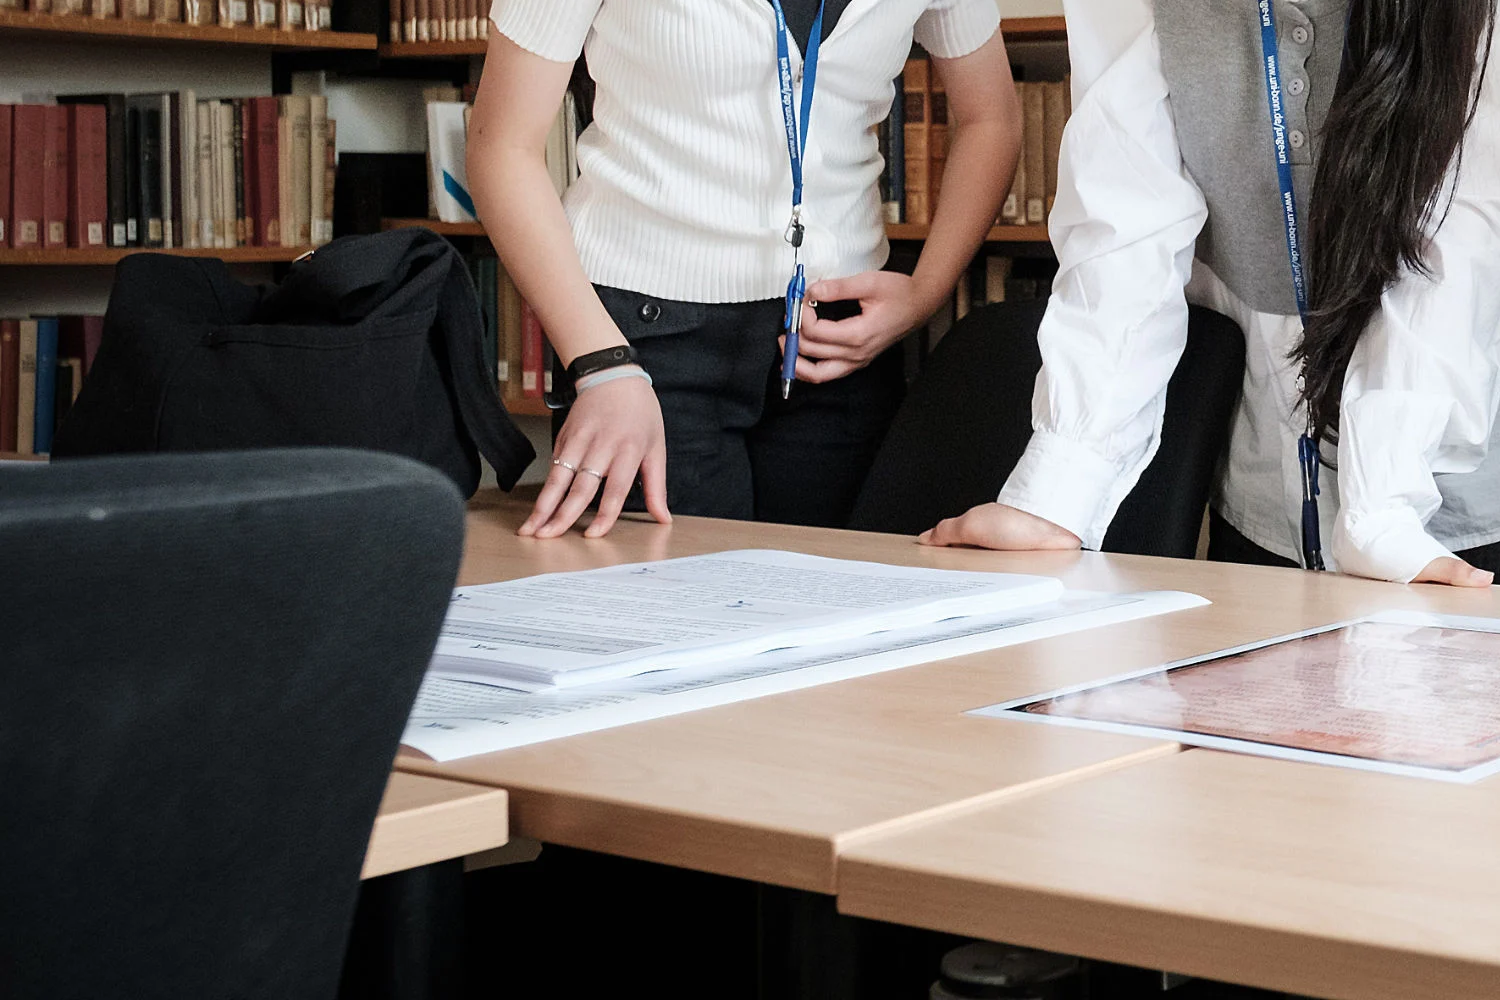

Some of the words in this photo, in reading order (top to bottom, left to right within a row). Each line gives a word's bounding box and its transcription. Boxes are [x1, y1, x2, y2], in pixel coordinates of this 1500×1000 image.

[779, 56, 798, 160] www.uni-bonn.de/junge-uni
[1267, 55, 1287, 164] www.uni-bonn.de/junge-uni
[1284, 191, 1305, 302] www.uni-bonn.de/junge-uni
